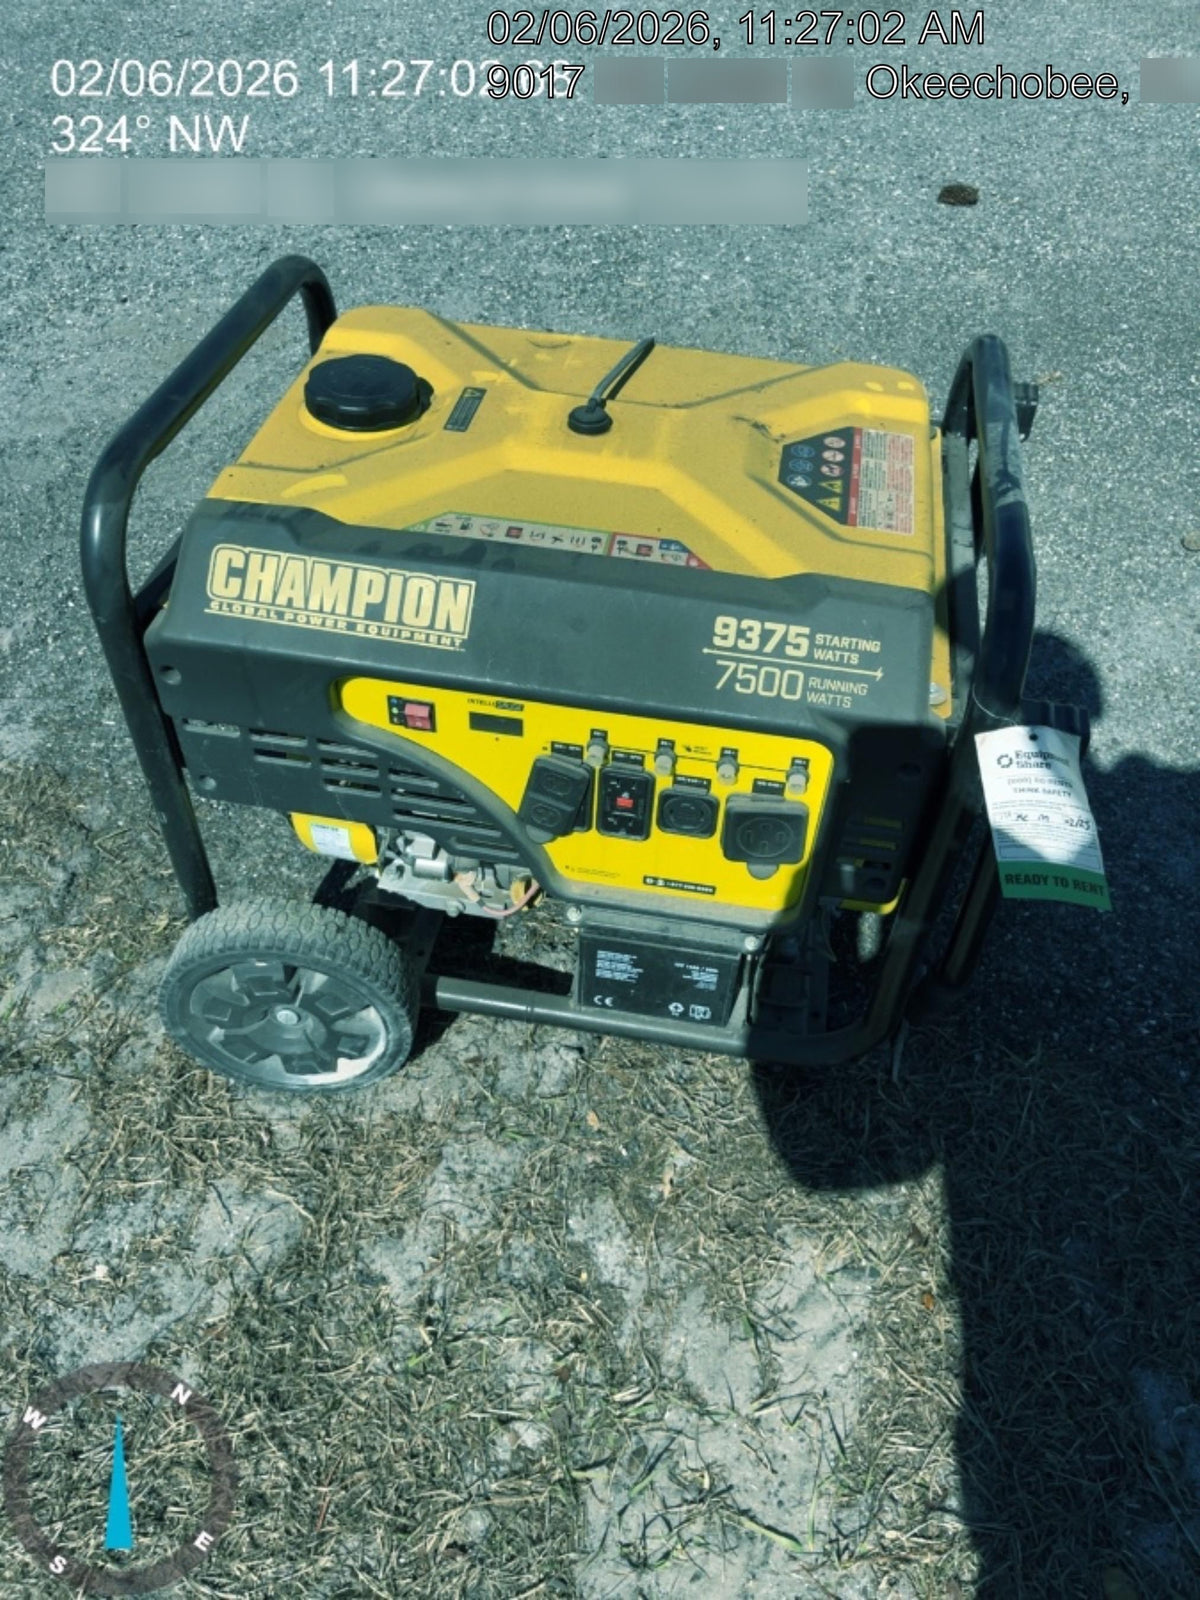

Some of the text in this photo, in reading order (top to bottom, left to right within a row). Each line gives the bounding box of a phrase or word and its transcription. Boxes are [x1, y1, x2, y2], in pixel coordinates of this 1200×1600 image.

[210, 547, 472, 634] CHAMPION
[209, 600, 464, 648] GLOBAL POWER EQUIPMENT
[712, 615, 811, 657] 9375
[814, 633, 881, 653] STARTING
[813, 648, 860, 665] WATTS
[714, 659, 805, 700] 7500
[808, 676, 869, 696] RUNNING
[806, 691, 852, 709] WATTS
[1004, 873, 1105, 897] READY TO RENT
